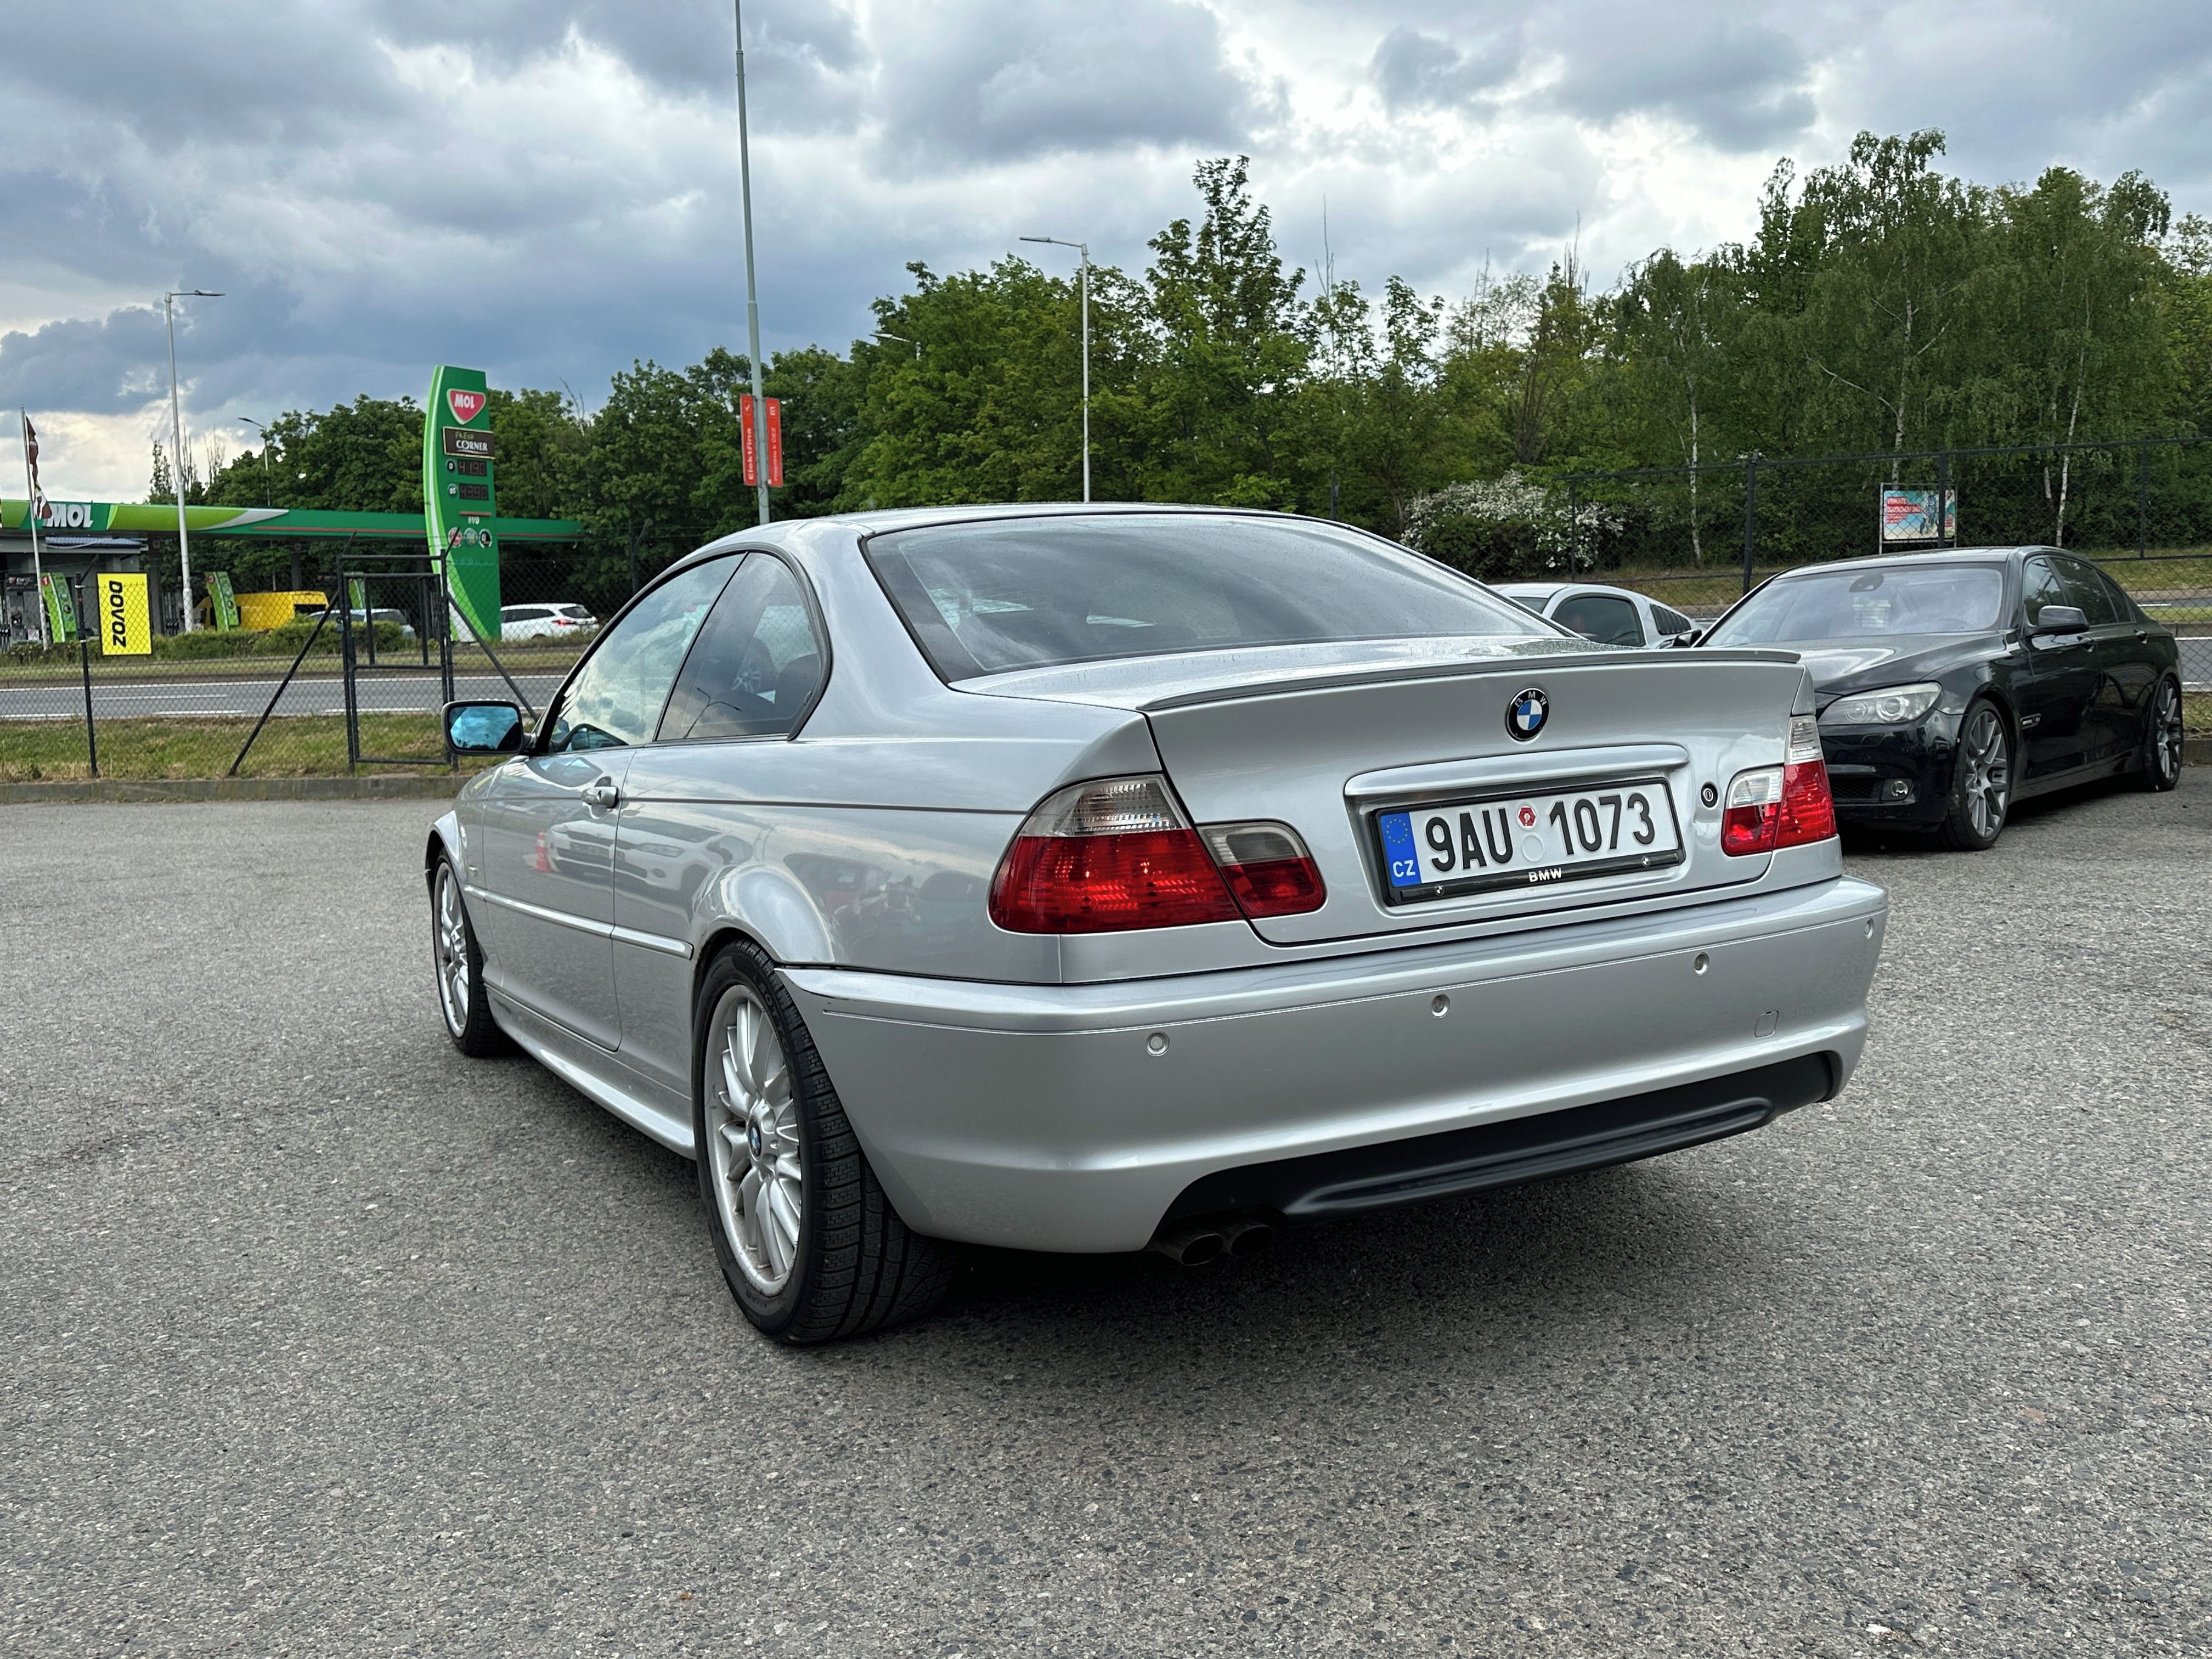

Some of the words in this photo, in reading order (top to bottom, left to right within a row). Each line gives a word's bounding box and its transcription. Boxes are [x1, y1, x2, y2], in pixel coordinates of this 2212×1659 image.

[454, 393, 475, 409] MOL
[456, 439, 488, 451] CORNER
[46, 504, 93, 527] MOL
[109, 580, 126, 648] DOVOZ
[1514, 691, 1547, 708] BMW
[1426, 808, 1514, 872] 9AU
[1549, 793, 1656, 855] 1073
[1392, 860, 1416, 878] CZ
[1528, 868, 1562, 883] BMW
